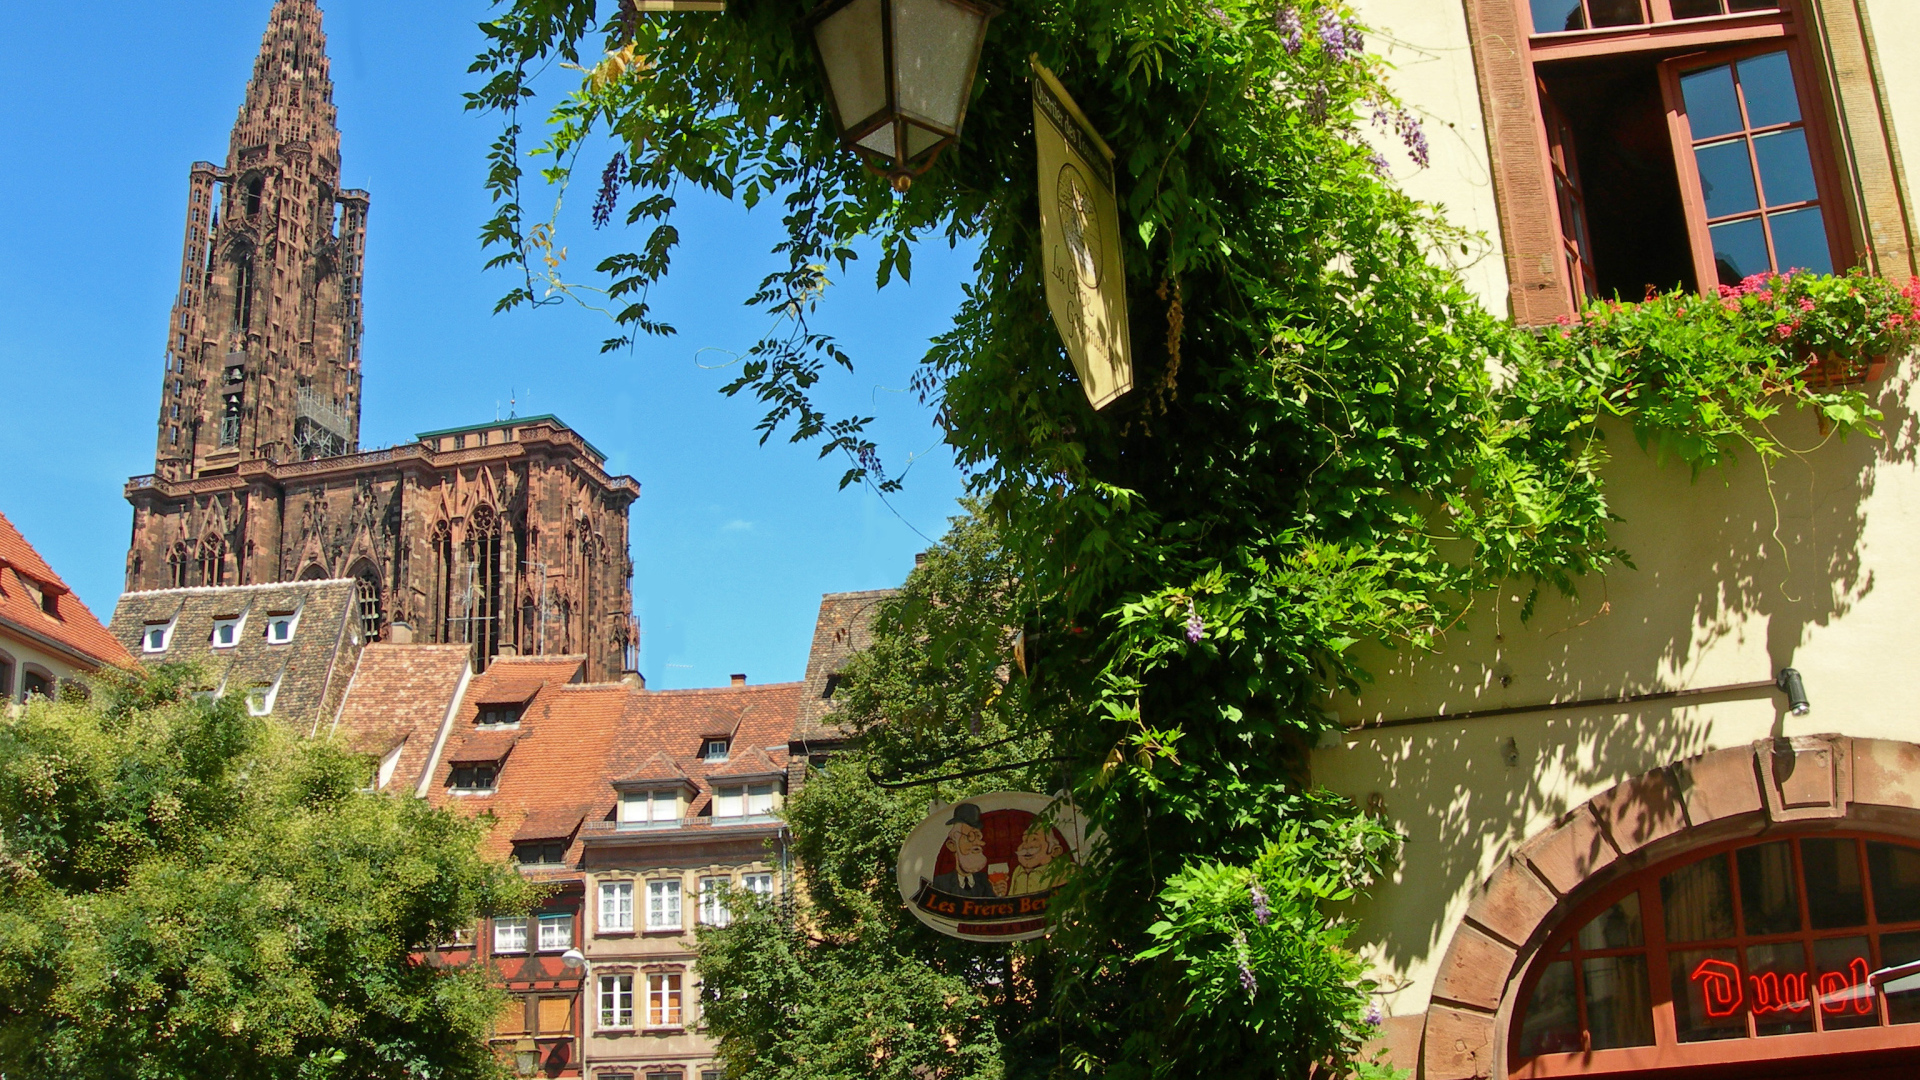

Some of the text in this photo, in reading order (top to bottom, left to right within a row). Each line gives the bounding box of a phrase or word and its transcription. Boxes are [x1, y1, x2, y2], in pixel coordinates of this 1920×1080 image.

[1052, 244, 1065, 285] La
[927, 894, 956, 914] Les
[1691, 956, 1874, 1017] Duvel
